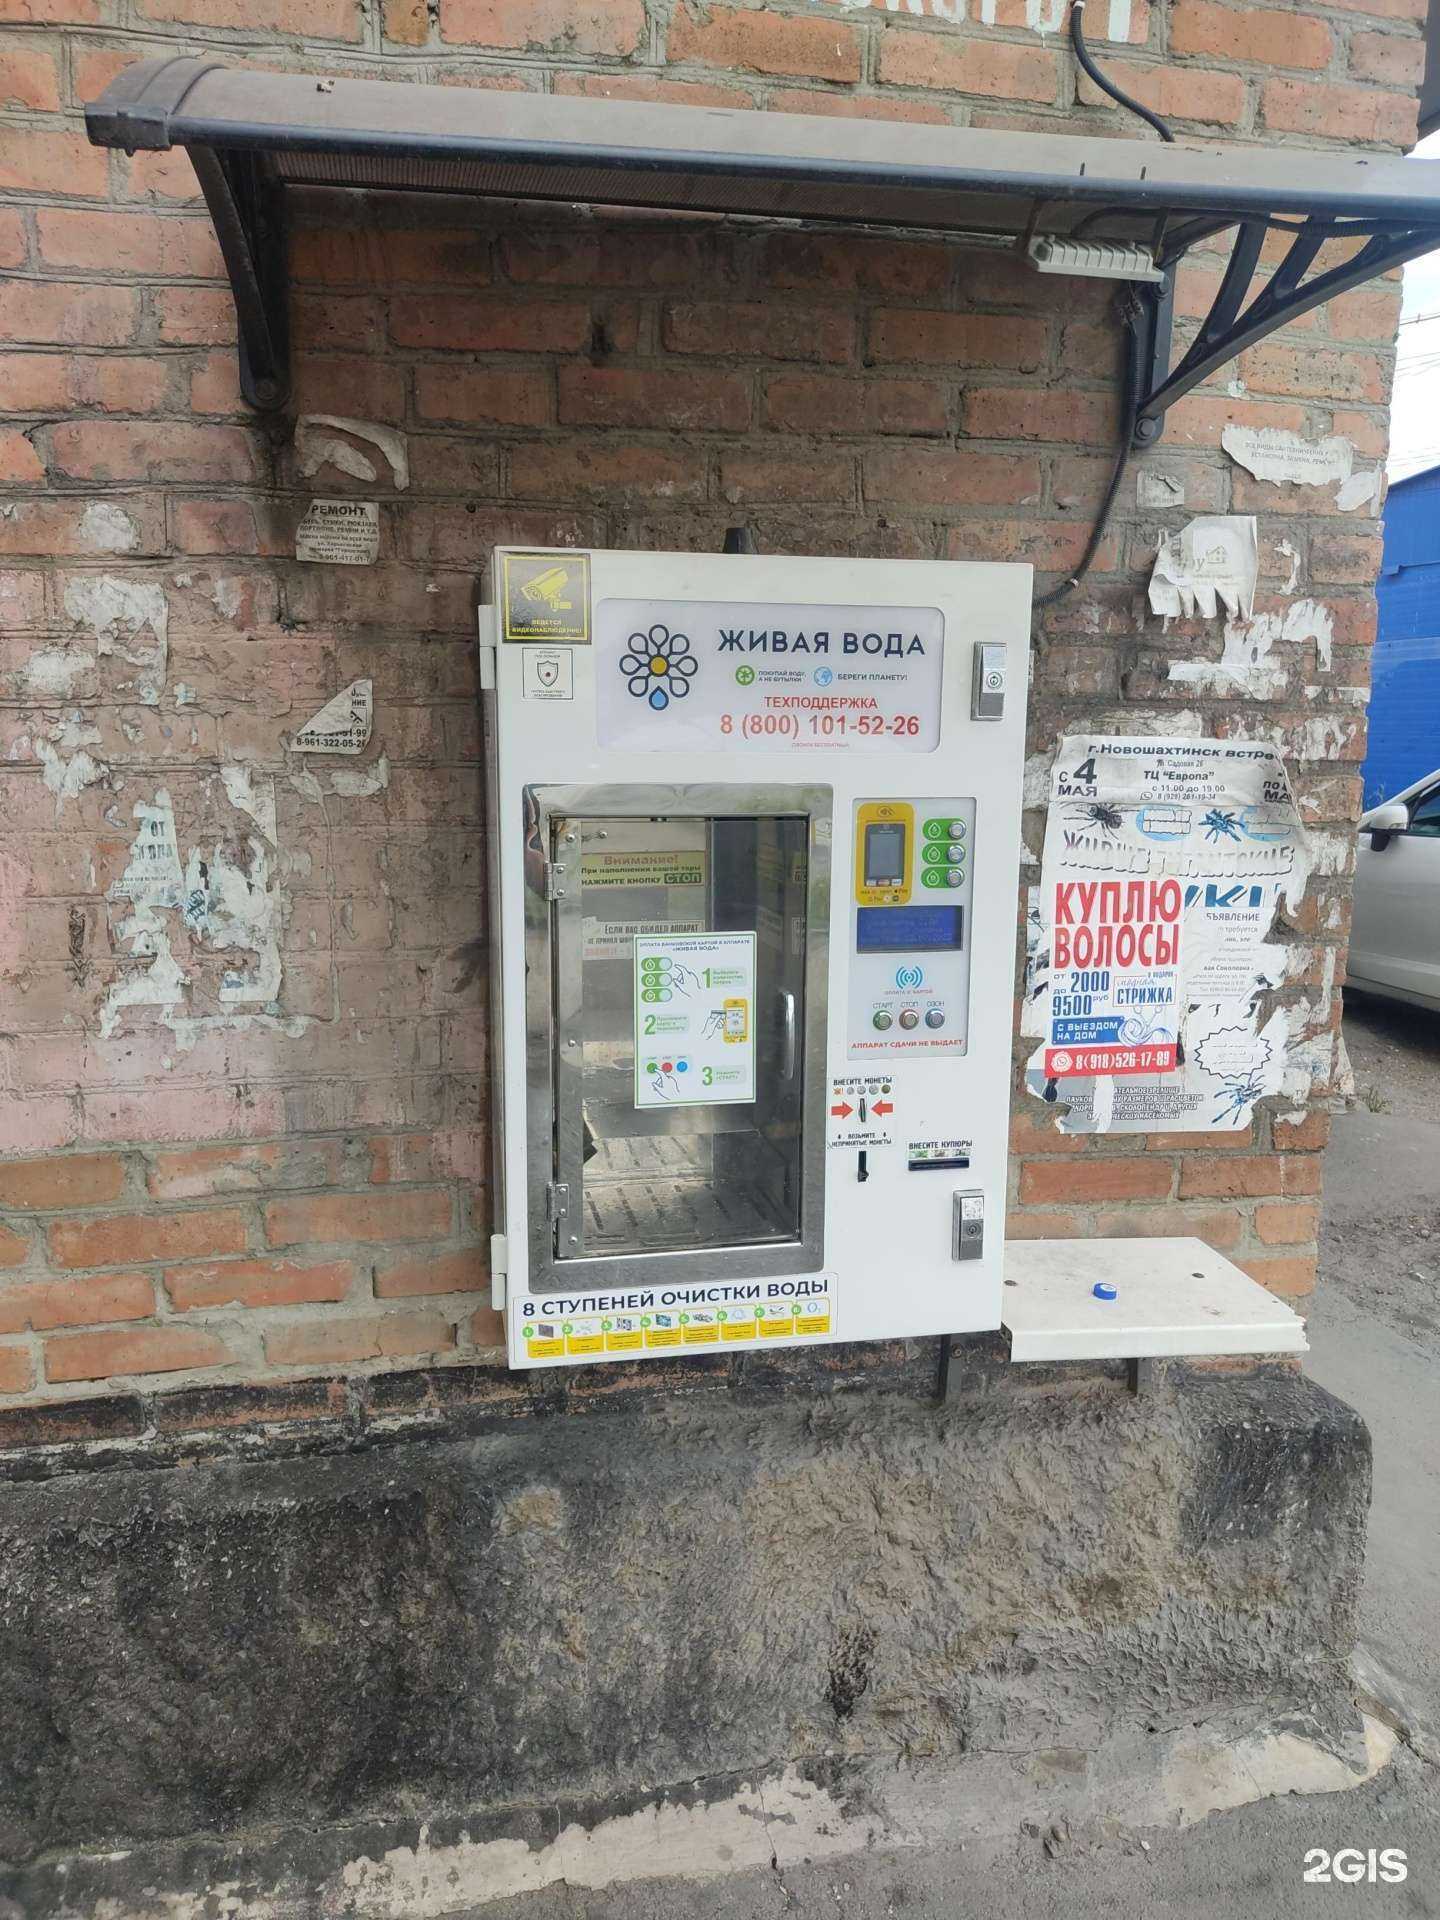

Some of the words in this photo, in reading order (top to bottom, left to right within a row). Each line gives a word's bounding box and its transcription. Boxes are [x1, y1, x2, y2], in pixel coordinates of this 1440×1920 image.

[311, 504, 366, 517] РЕМОНТ
[717, 629, 829, 654] ЖИВАЯ
[842, 632, 926, 659] ВОДА
[837, 673, 867, 681] БЕРЕГИ
[868, 673, 908, 681] ПЛАНЕТУ!
[764, 696, 878, 710] ТЕХПОДДЕРЖКА
[720, 714, 733, 735] 8
[742, 714, 800, 740] (800)
[808, 715, 920, 736] 101-52-26
[1088, 743, 1222, 758] г.Новошахтинск
[1073, 758, 1098, 785] 4
[1144, 770, 1160, 782] ТЦ
[1058, 784, 1098, 797] МАЯ
[1263, 780, 1280, 790] по
[1264, 789, 1293, 804] МА
[603, 854, 679, 866] Внимание!
[581, 867, 598, 875] При
[580, 878, 625, 886] НАЖМИТЕ
[626, 876, 662, 885] КНОПКУ
[665, 873, 701, 884] СТОП
[1055, 879, 1182, 925] КУПЛЮ
[1054, 924, 1180, 970] ВОЛОСЫ
[702, 967, 711, 989] 1
[1070, 971, 1110, 993] 2000
[1117, 987, 1173, 1005] СТРИЖКА
[926, 1000, 945, 1008] ОЗОН
[1052, 994, 1093, 1017] 9500
[644, 1014, 657, 1035] 2
[1057, 1023, 1063, 1032] С
[1067, 1022, 1119, 1032] ВЫЕЗДОМ
[1056, 1032, 1071, 1041] НА
[1074, 1032, 1097, 1041] ДОМ
[851, 1041, 888, 1049] АППАРАТ
[889, 1041, 917, 1050] СДАЧИ
[930, 1039, 963, 1047] ВЫДАЕТ
[702, 1066, 713, 1086] 3
[833, 1078, 863, 1086] ВНЕСИТЕ
[864, 1076, 893, 1085] МОНЕТЫ
[868, 1138, 892, 1146] МОНЕТЫ
[908, 1141, 939, 1150] ВНЕСИТЕ
[941, 1139, 973, 1149] КУПЮРЫ
[523, 1302, 535, 1317] 8
[541, 1289, 654, 1316] СТУПЕНЕЙ
[661, 1284, 760, 1306] ОЧИСТКИ
[767, 1279, 828, 1298] ВОДЫ
